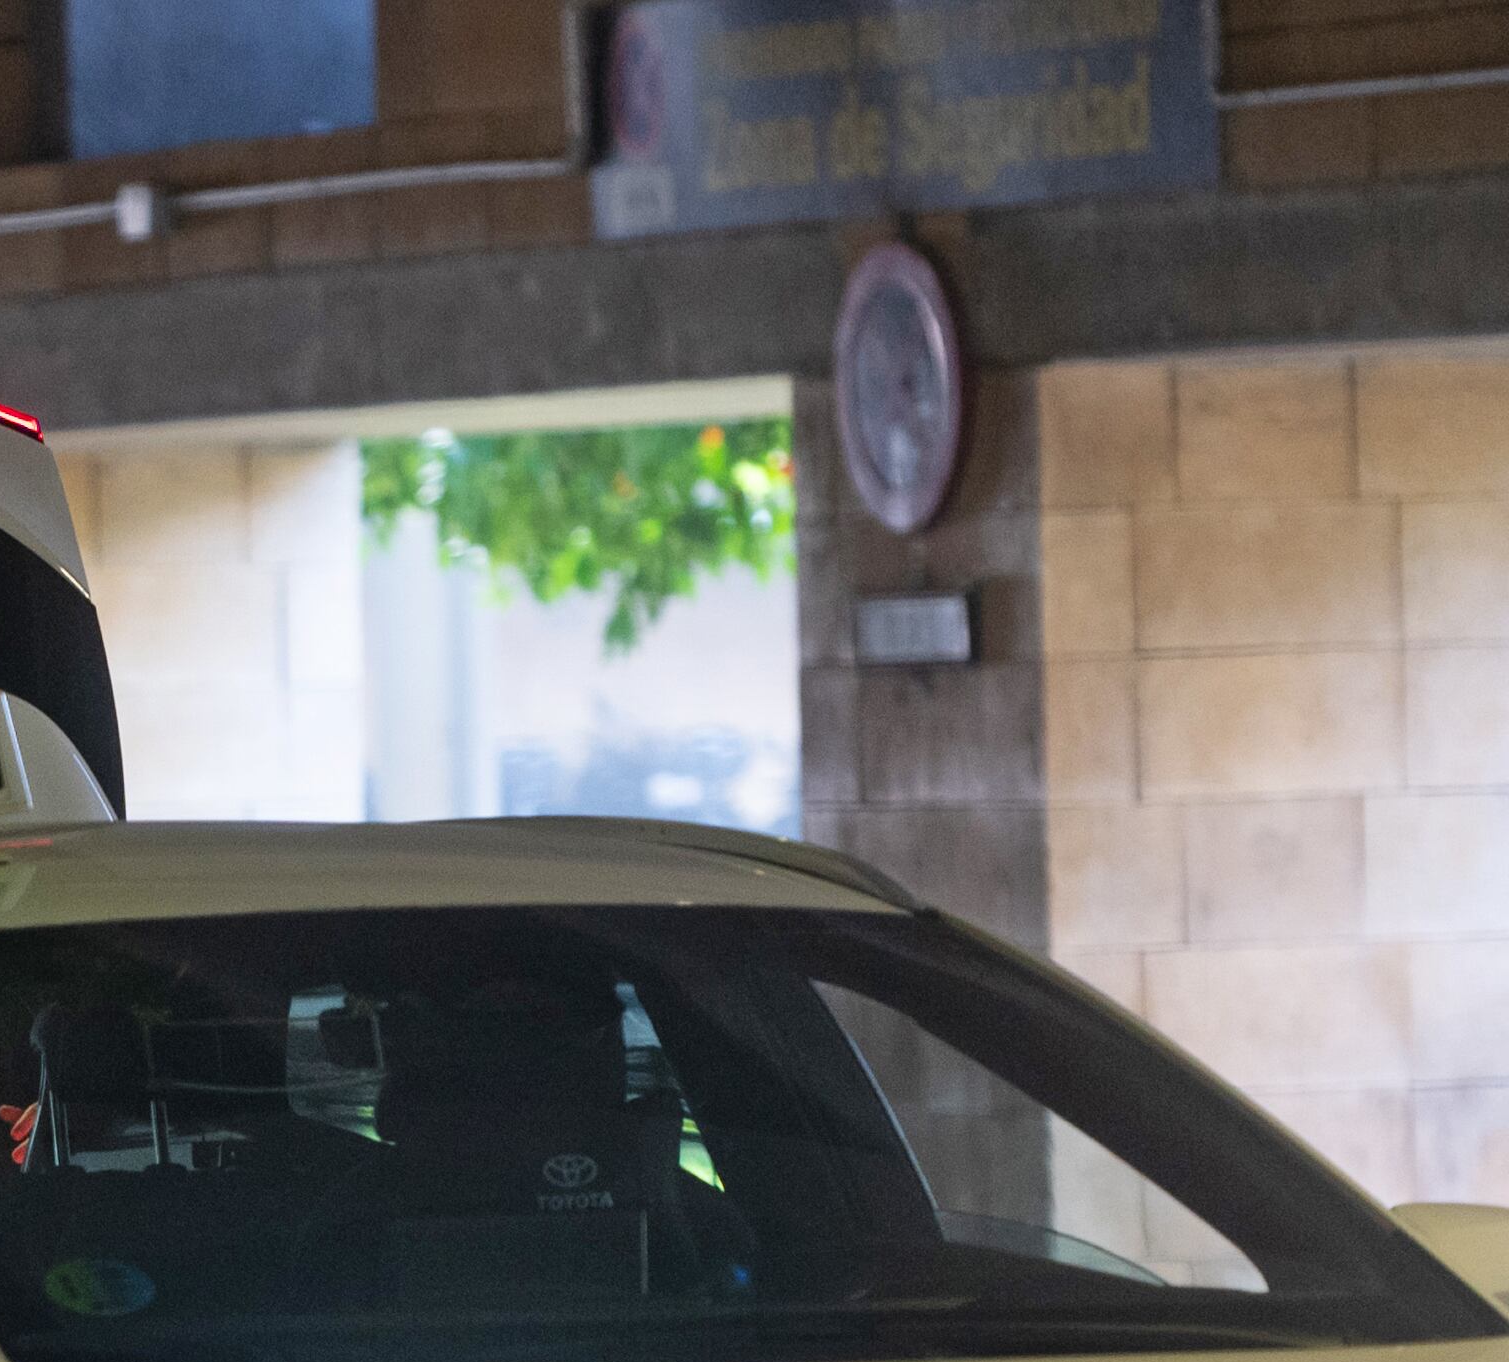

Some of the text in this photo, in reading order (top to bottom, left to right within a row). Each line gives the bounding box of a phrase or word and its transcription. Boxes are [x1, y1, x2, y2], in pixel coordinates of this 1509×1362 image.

[830, 77, 886, 181] de
[898, 52, 1151, 192] Seguridad
[537, 1191, 615, 1211] TOYOTA
